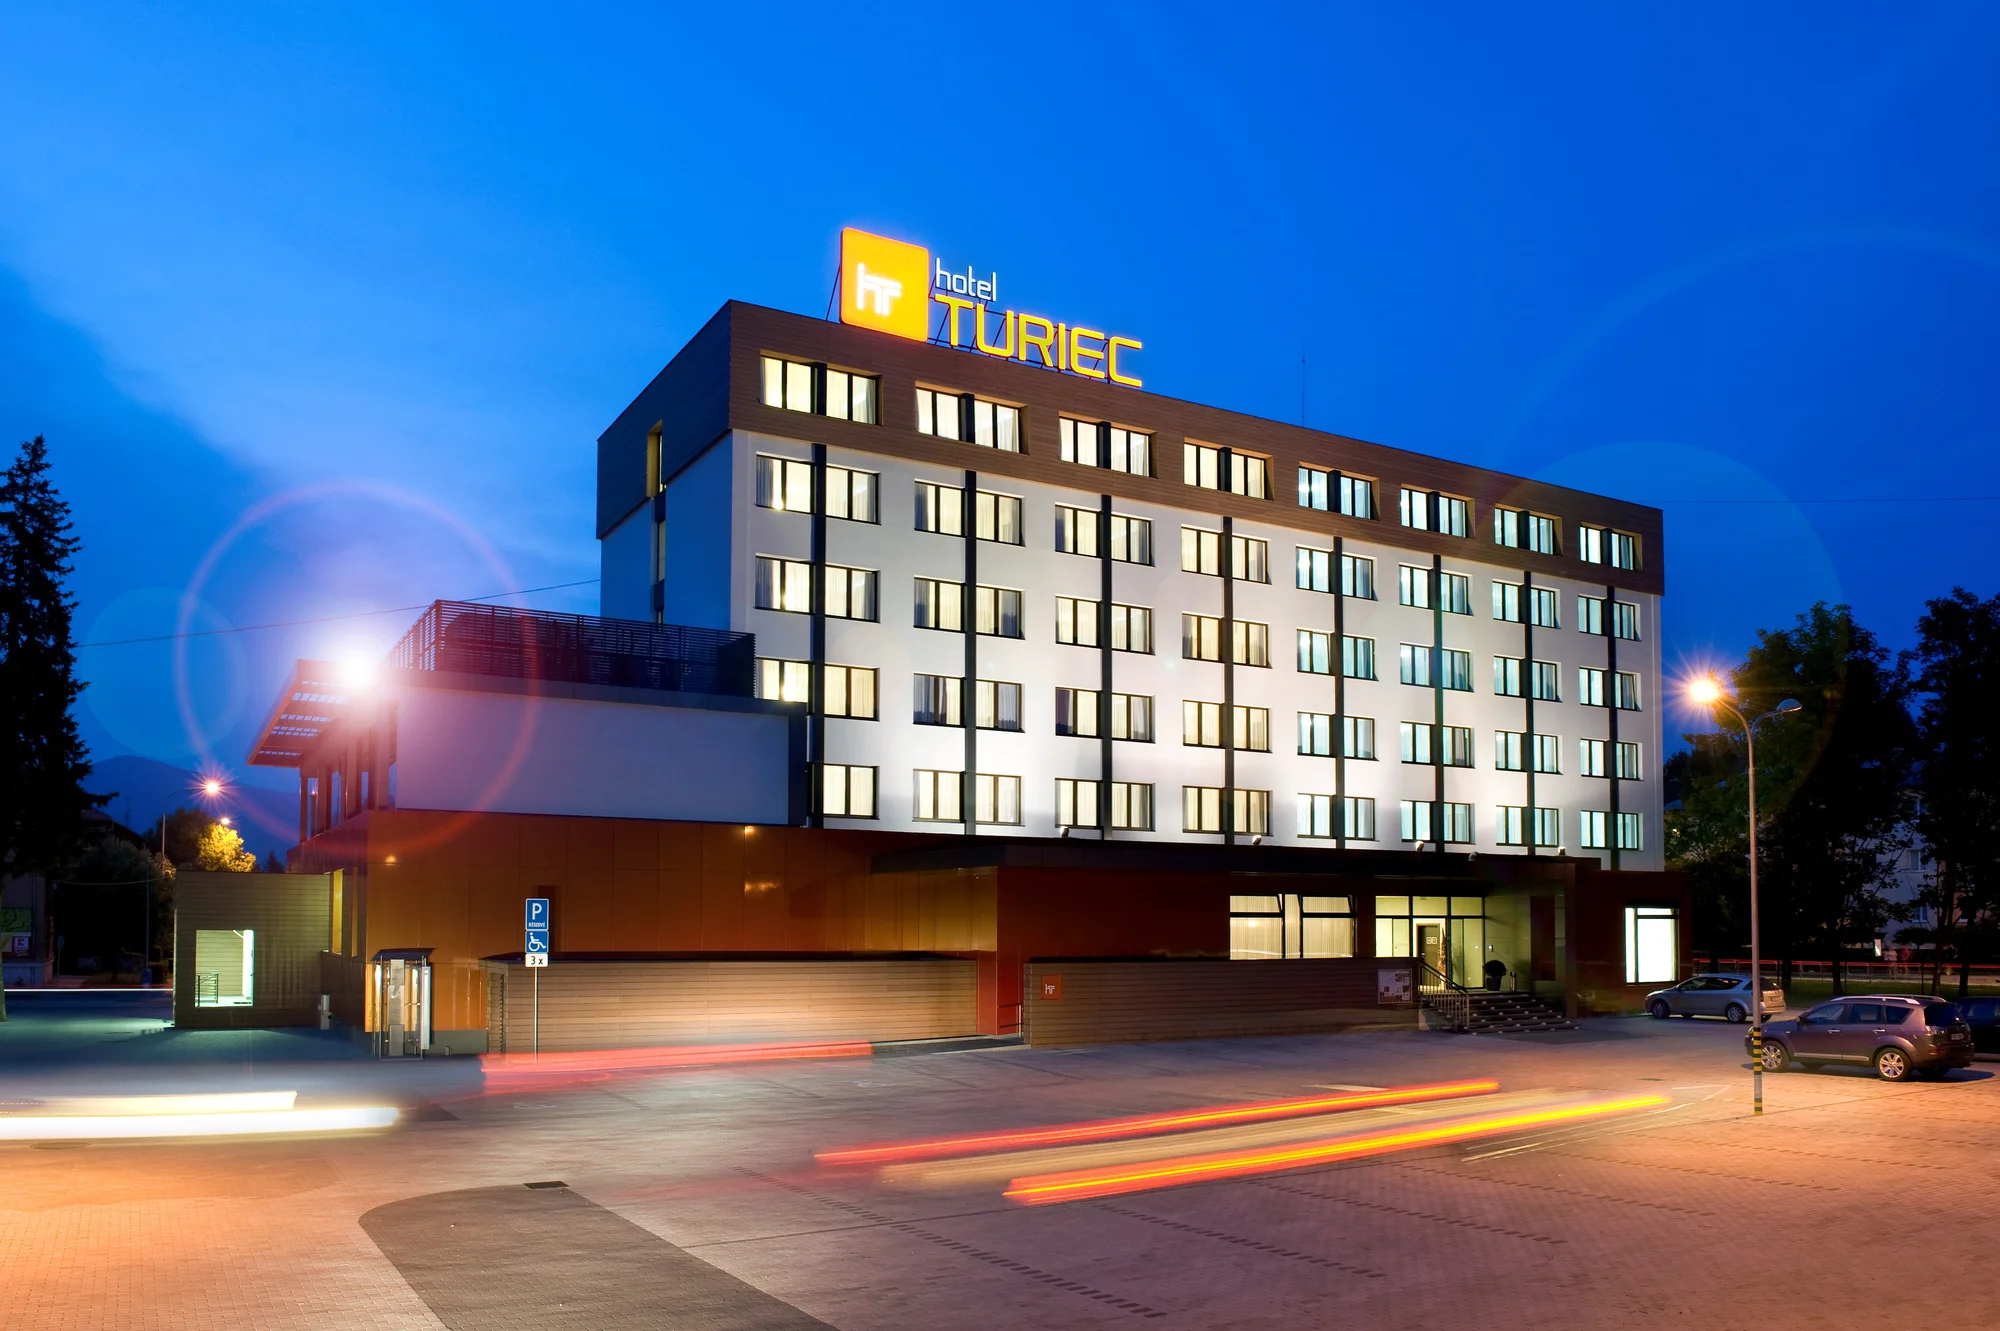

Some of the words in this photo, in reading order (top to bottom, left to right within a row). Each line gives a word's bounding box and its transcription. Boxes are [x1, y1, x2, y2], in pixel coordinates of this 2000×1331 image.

[936, 257, 997, 302] hotel
[934, 293, 1143, 388] TURIEC
[532, 902, 543, 920] P
